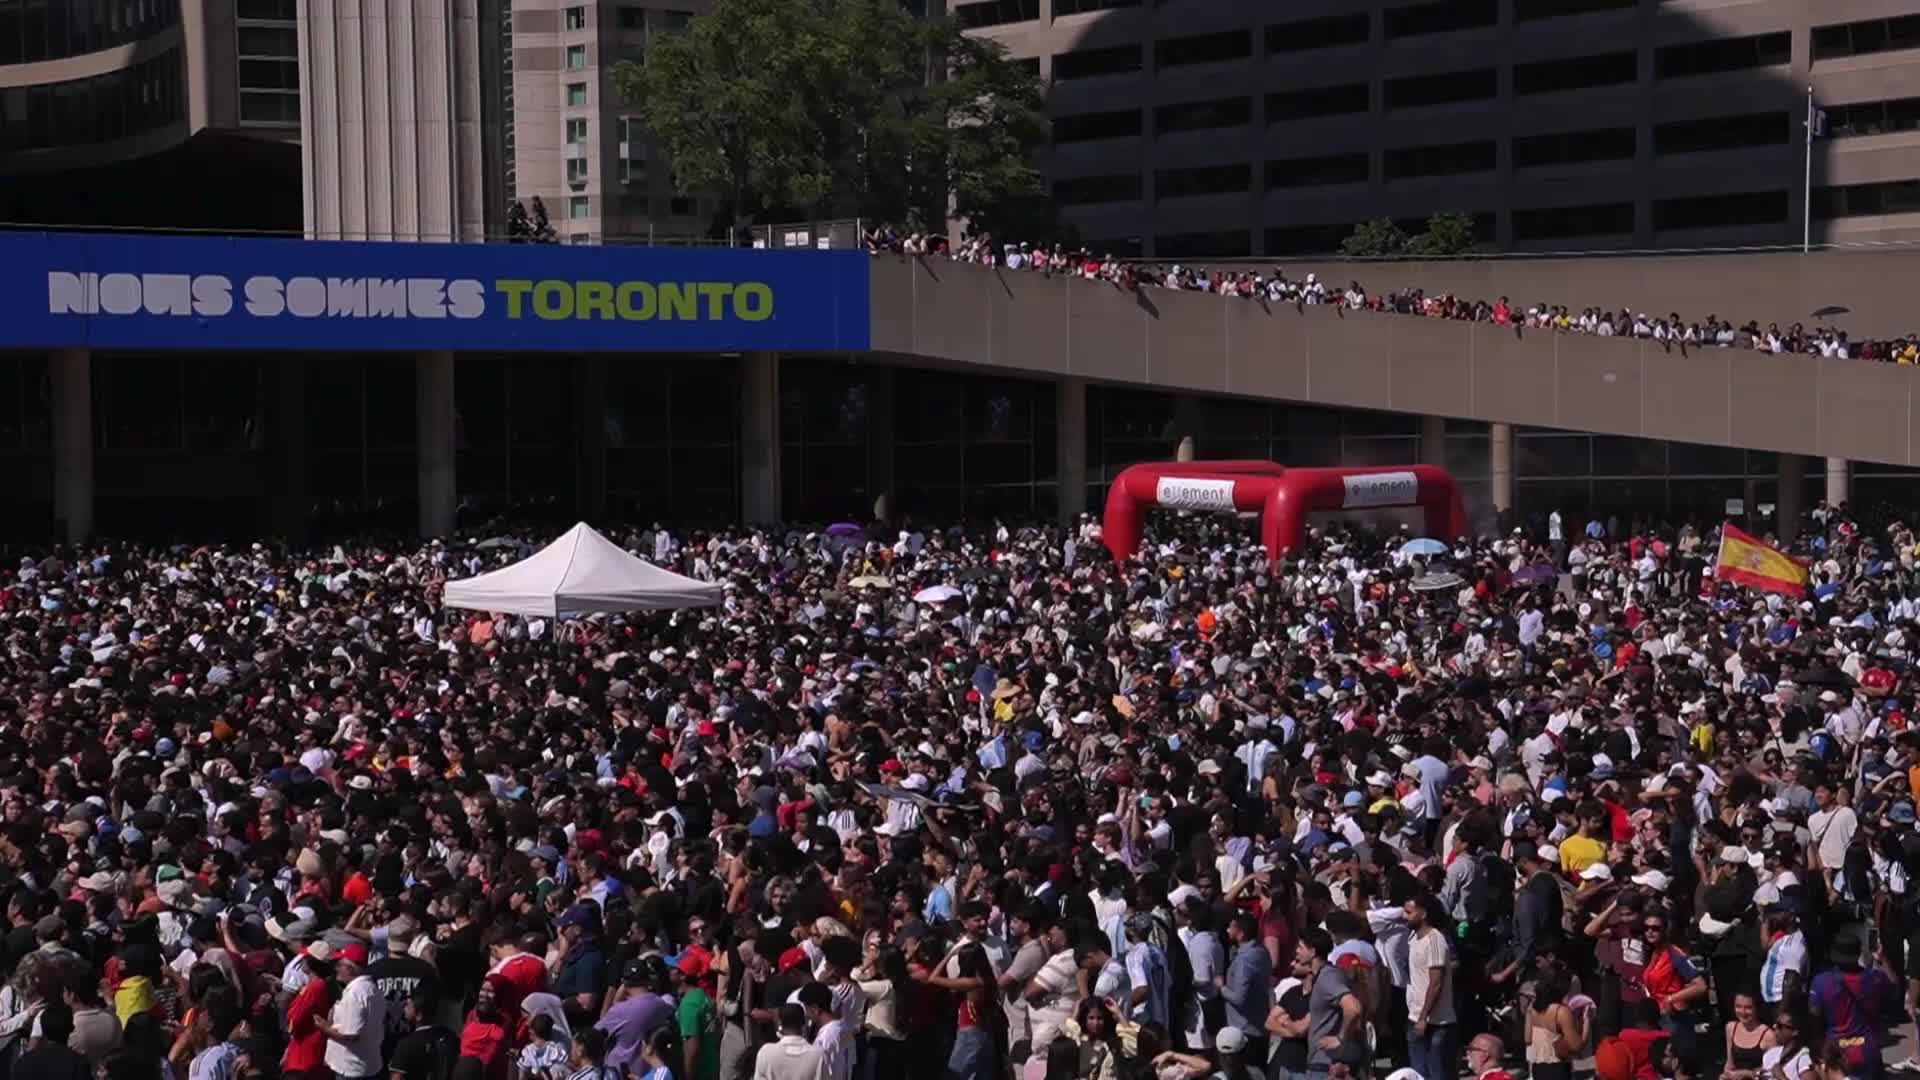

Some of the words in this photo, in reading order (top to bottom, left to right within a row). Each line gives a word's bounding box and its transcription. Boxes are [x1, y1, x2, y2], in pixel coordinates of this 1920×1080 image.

[48, 271, 232, 316] NOUS
[244, 276, 485, 319] SOMMES
[495, 279, 774, 321] TORONTO
